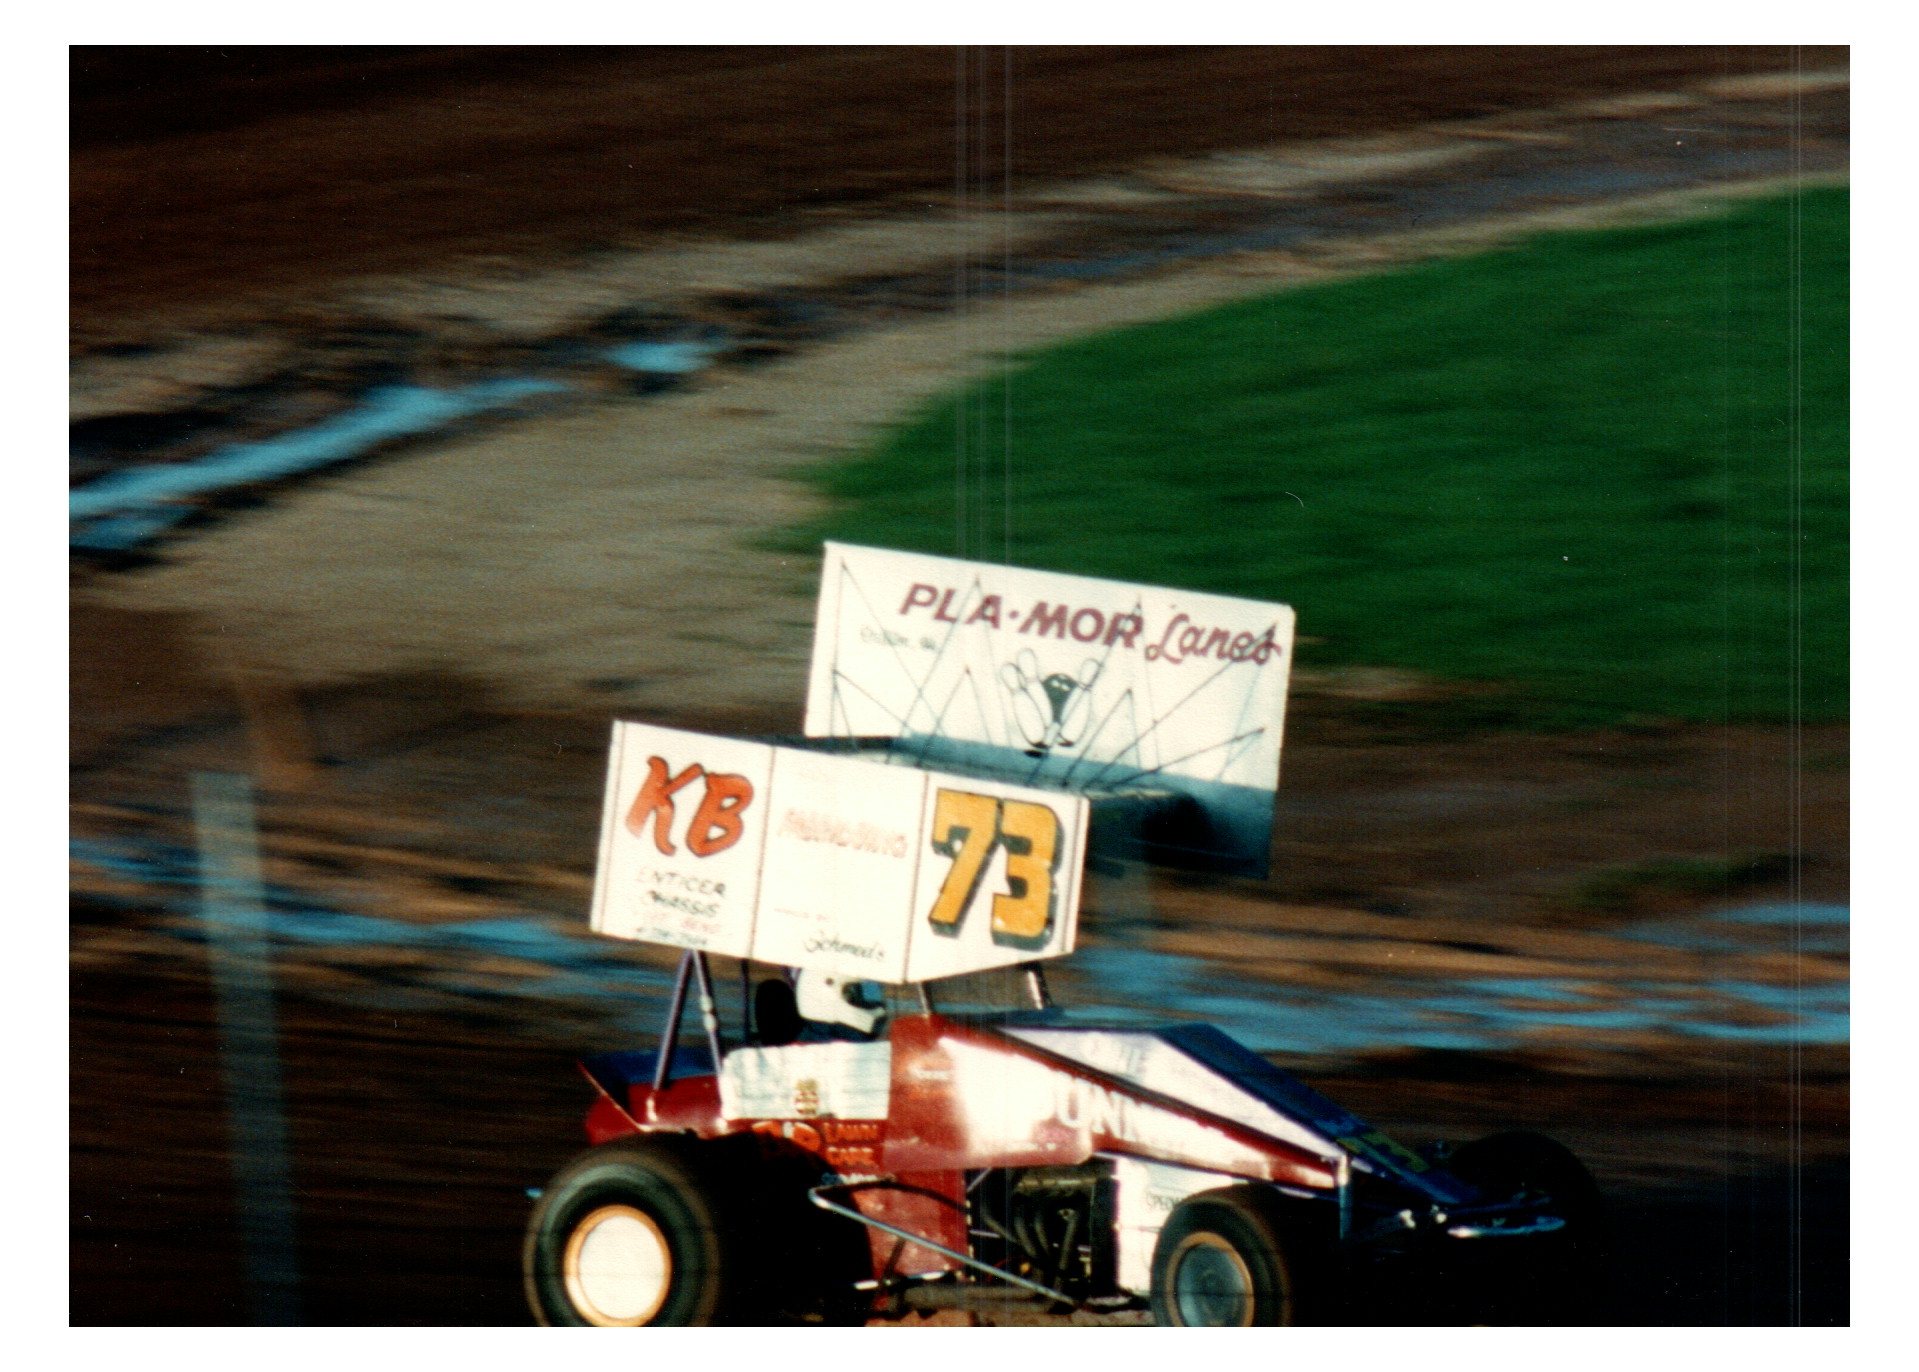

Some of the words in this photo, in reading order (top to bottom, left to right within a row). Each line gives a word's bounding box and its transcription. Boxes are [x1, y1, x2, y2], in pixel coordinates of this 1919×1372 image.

[1145, 612, 1283, 664] Lanes
[624, 755, 755, 858] KB
[928, 787, 1064, 952] 73
